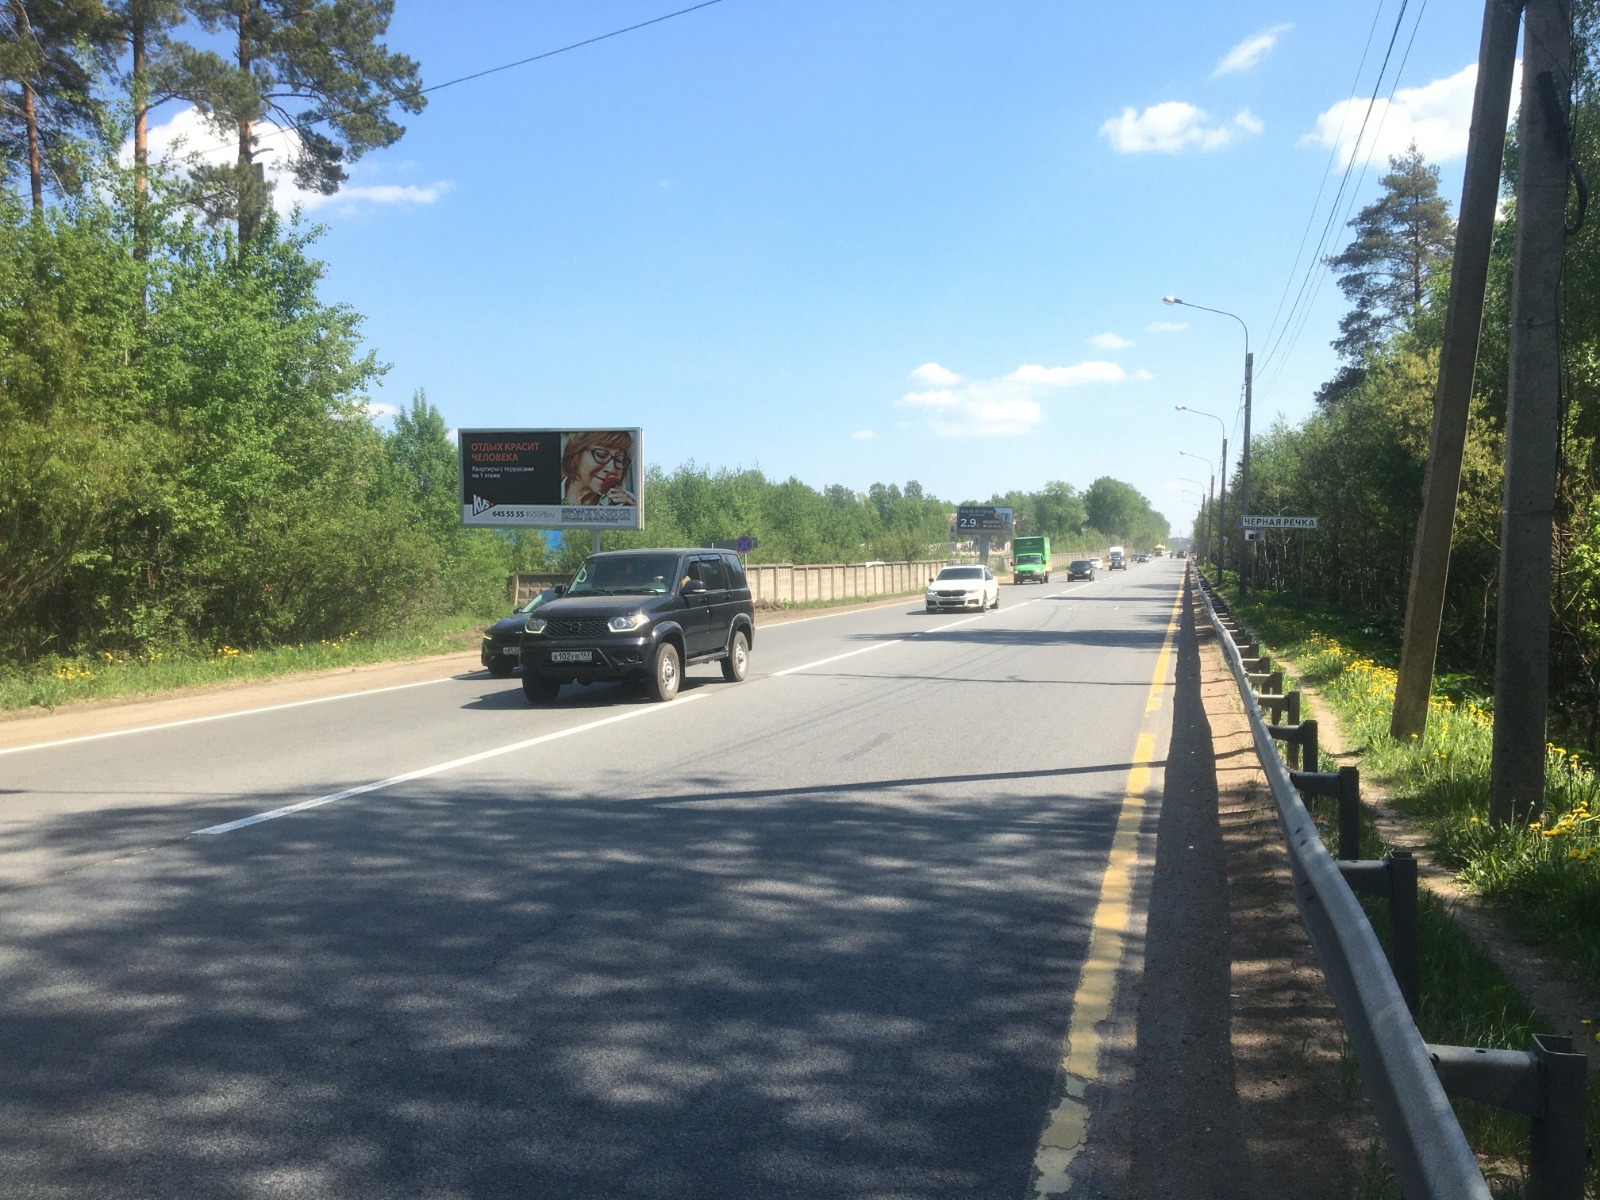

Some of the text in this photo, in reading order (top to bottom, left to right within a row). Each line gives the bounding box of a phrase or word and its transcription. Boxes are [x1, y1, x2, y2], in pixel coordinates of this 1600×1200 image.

[471, 442, 540, 452] ОТДЫХ КРАСИТ
[471, 453, 519, 462] ЧЕЛОВЕКА
[960, 518, 977, 528] 2.9
[1244, 517, 1315, 527] ЧЕРНАЯ РЕЧКА
